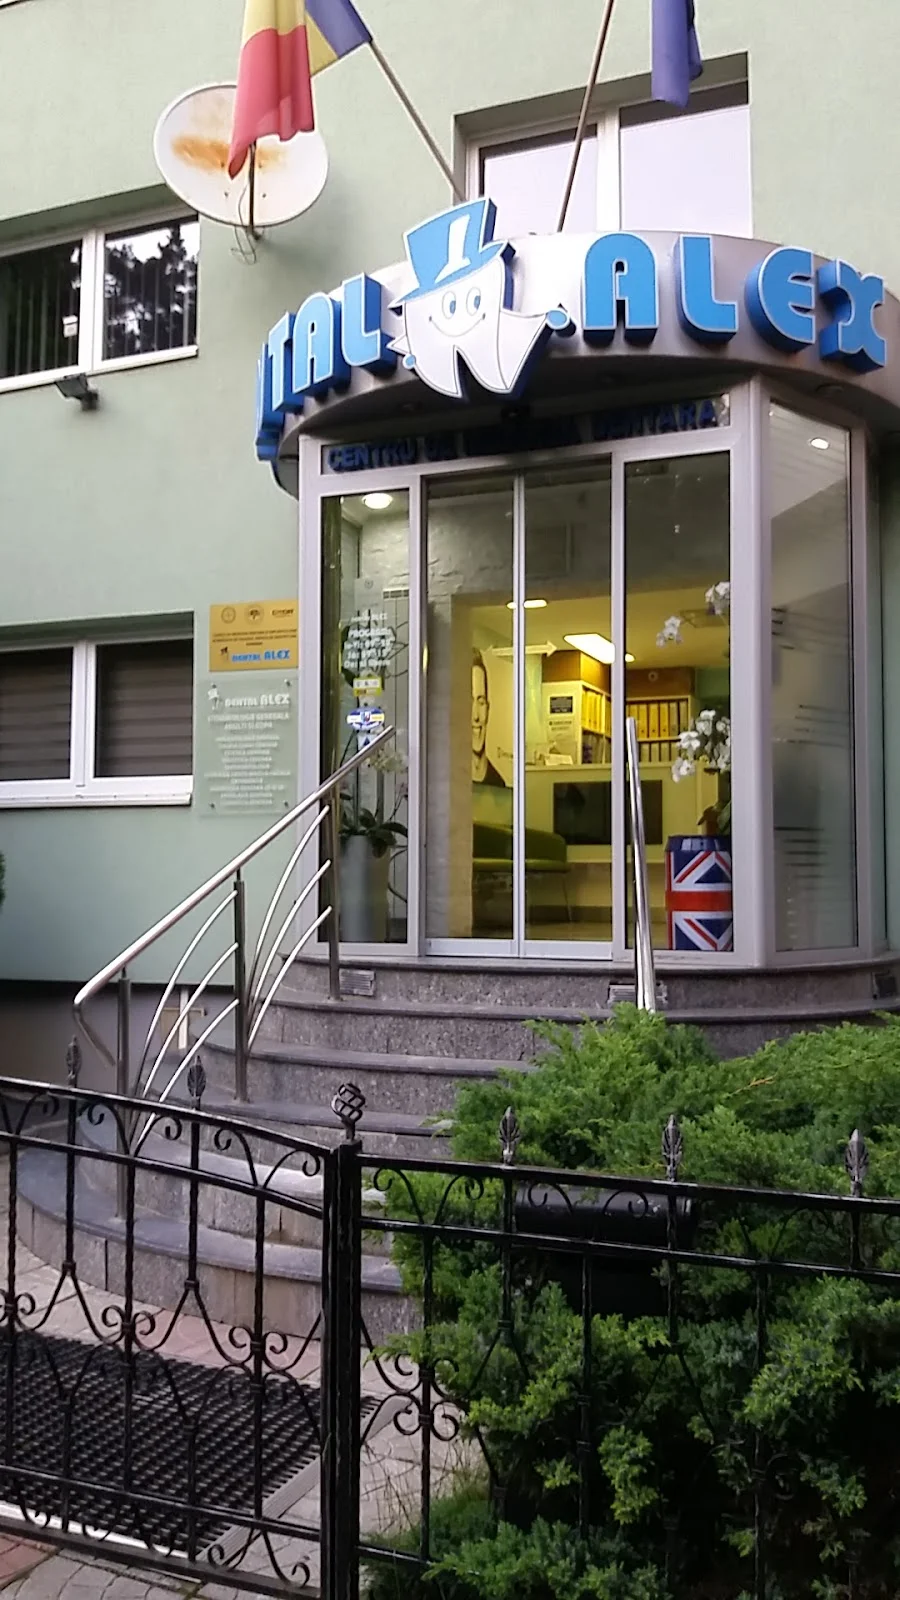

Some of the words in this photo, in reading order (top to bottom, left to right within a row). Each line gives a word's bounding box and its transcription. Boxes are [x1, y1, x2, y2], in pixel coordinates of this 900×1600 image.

[581, 231, 888, 373] ALEX
[328, 437, 416, 472] CENTRU
[263, 649, 290, 660] ALEX
[260, 692, 290, 705] ALEX
